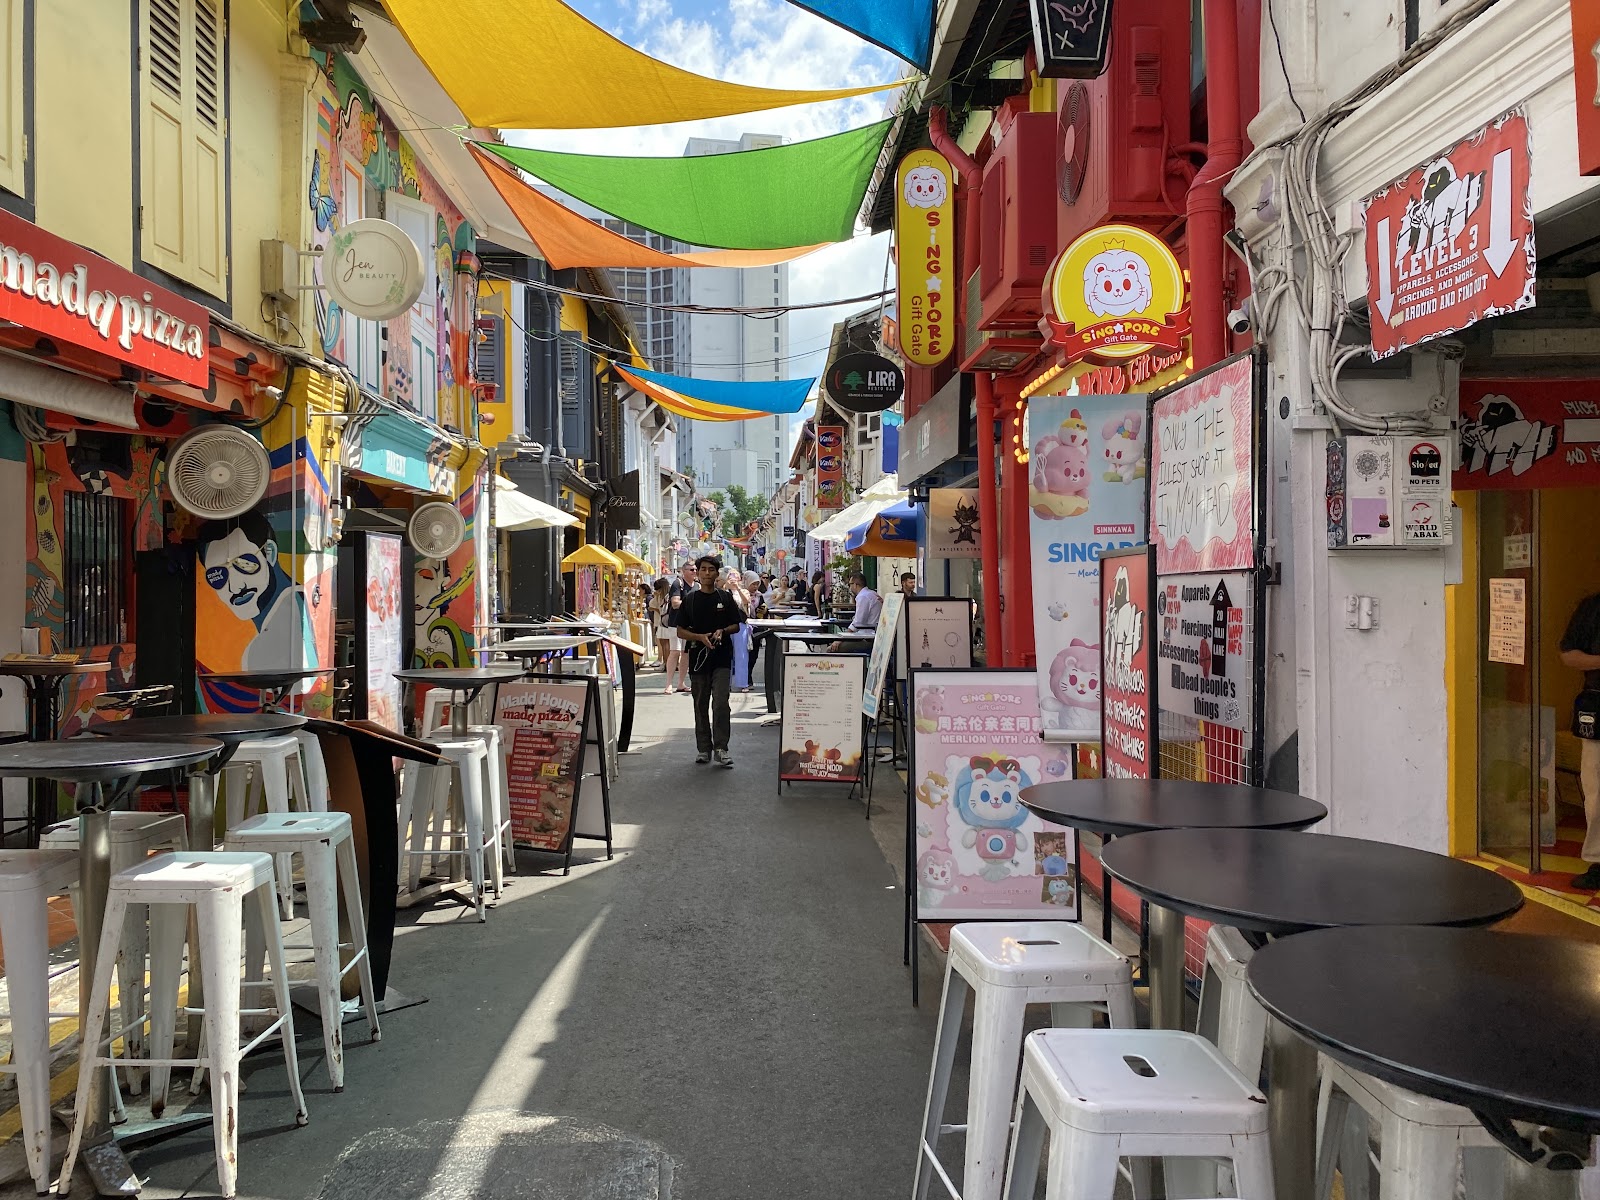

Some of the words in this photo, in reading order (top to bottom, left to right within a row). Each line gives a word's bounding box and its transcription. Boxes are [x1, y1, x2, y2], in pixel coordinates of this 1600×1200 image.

[1398, 233, 1462, 282] LEVEL
[1469, 224, 1479, 250] 3
[343, 248, 374, 282] Jen
[1437, 279, 1453, 293] AND
[911, 295, 923, 321] Gift
[1404, 298, 1437, 322] AROUND
[1439, 291, 1456, 310] AND
[1457, 282, 1474, 302] FIND
[1474, 273, 1489, 293] OUT
[118, 291, 205, 359] pizza
[911, 322, 923, 356] Gate
[1104, 335, 1119, 344] Gift
[1120, 333, 1138, 342] Gate
[868, 371, 897, 387] LIRA
[1163, 420, 1187, 452] ONLY
[1194, 408, 1225, 449] THE
[1158, 461, 1188, 486] ILLEST
[1190, 452, 1210, 479] SHOP
[1212, 448, 1226, 473] AT
[608, 495, 638, 507] Beau
[1195, 482, 1231, 527] HEAD
[1096, 525, 1133, 534] SINNKAWA
[1181, 584, 1211, 602] Apparels
[1216, 609, 1224, 622] 20
[1227, 608, 1243, 623] THIS
[1180, 619, 1212, 640] Piercings
[1227, 624, 1243, 639] WAY
[1158, 640, 1199, 666] Accessories
[1213, 644, 1225, 657] LANE
[1180, 671, 1198, 692] Dead
[1200, 677, 1236, 699] people's
[500, 691, 537, 710] Madd
[539, 692, 580, 714] Hours
[1193, 698, 1219, 720] things
[537, 711, 571, 724] pizza
[941, 735, 987, 744] MERLION
[991, 735, 1018, 744] WITH
